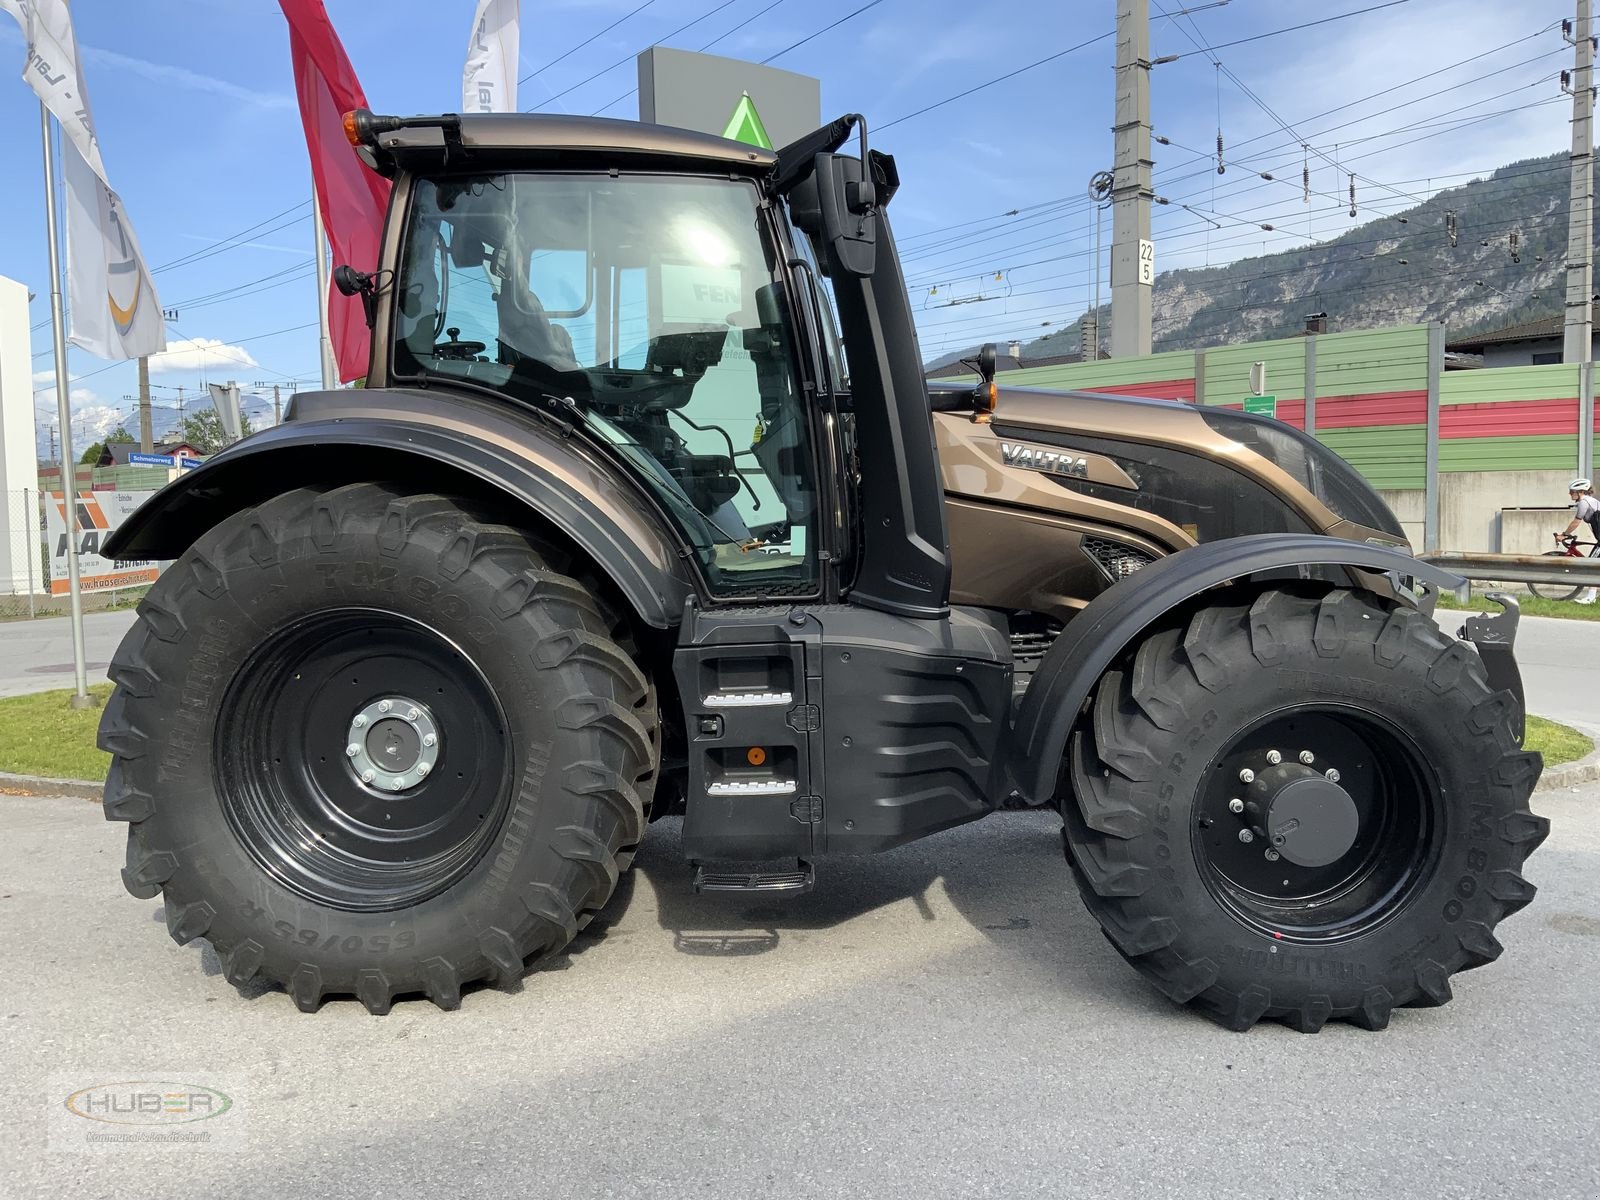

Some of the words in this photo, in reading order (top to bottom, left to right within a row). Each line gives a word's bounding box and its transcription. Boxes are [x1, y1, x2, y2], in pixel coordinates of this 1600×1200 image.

[1141, 243, 1152, 262] 22
[1143, 264, 1150, 280] 5
[1001, 443, 1089, 479] VALTRA
